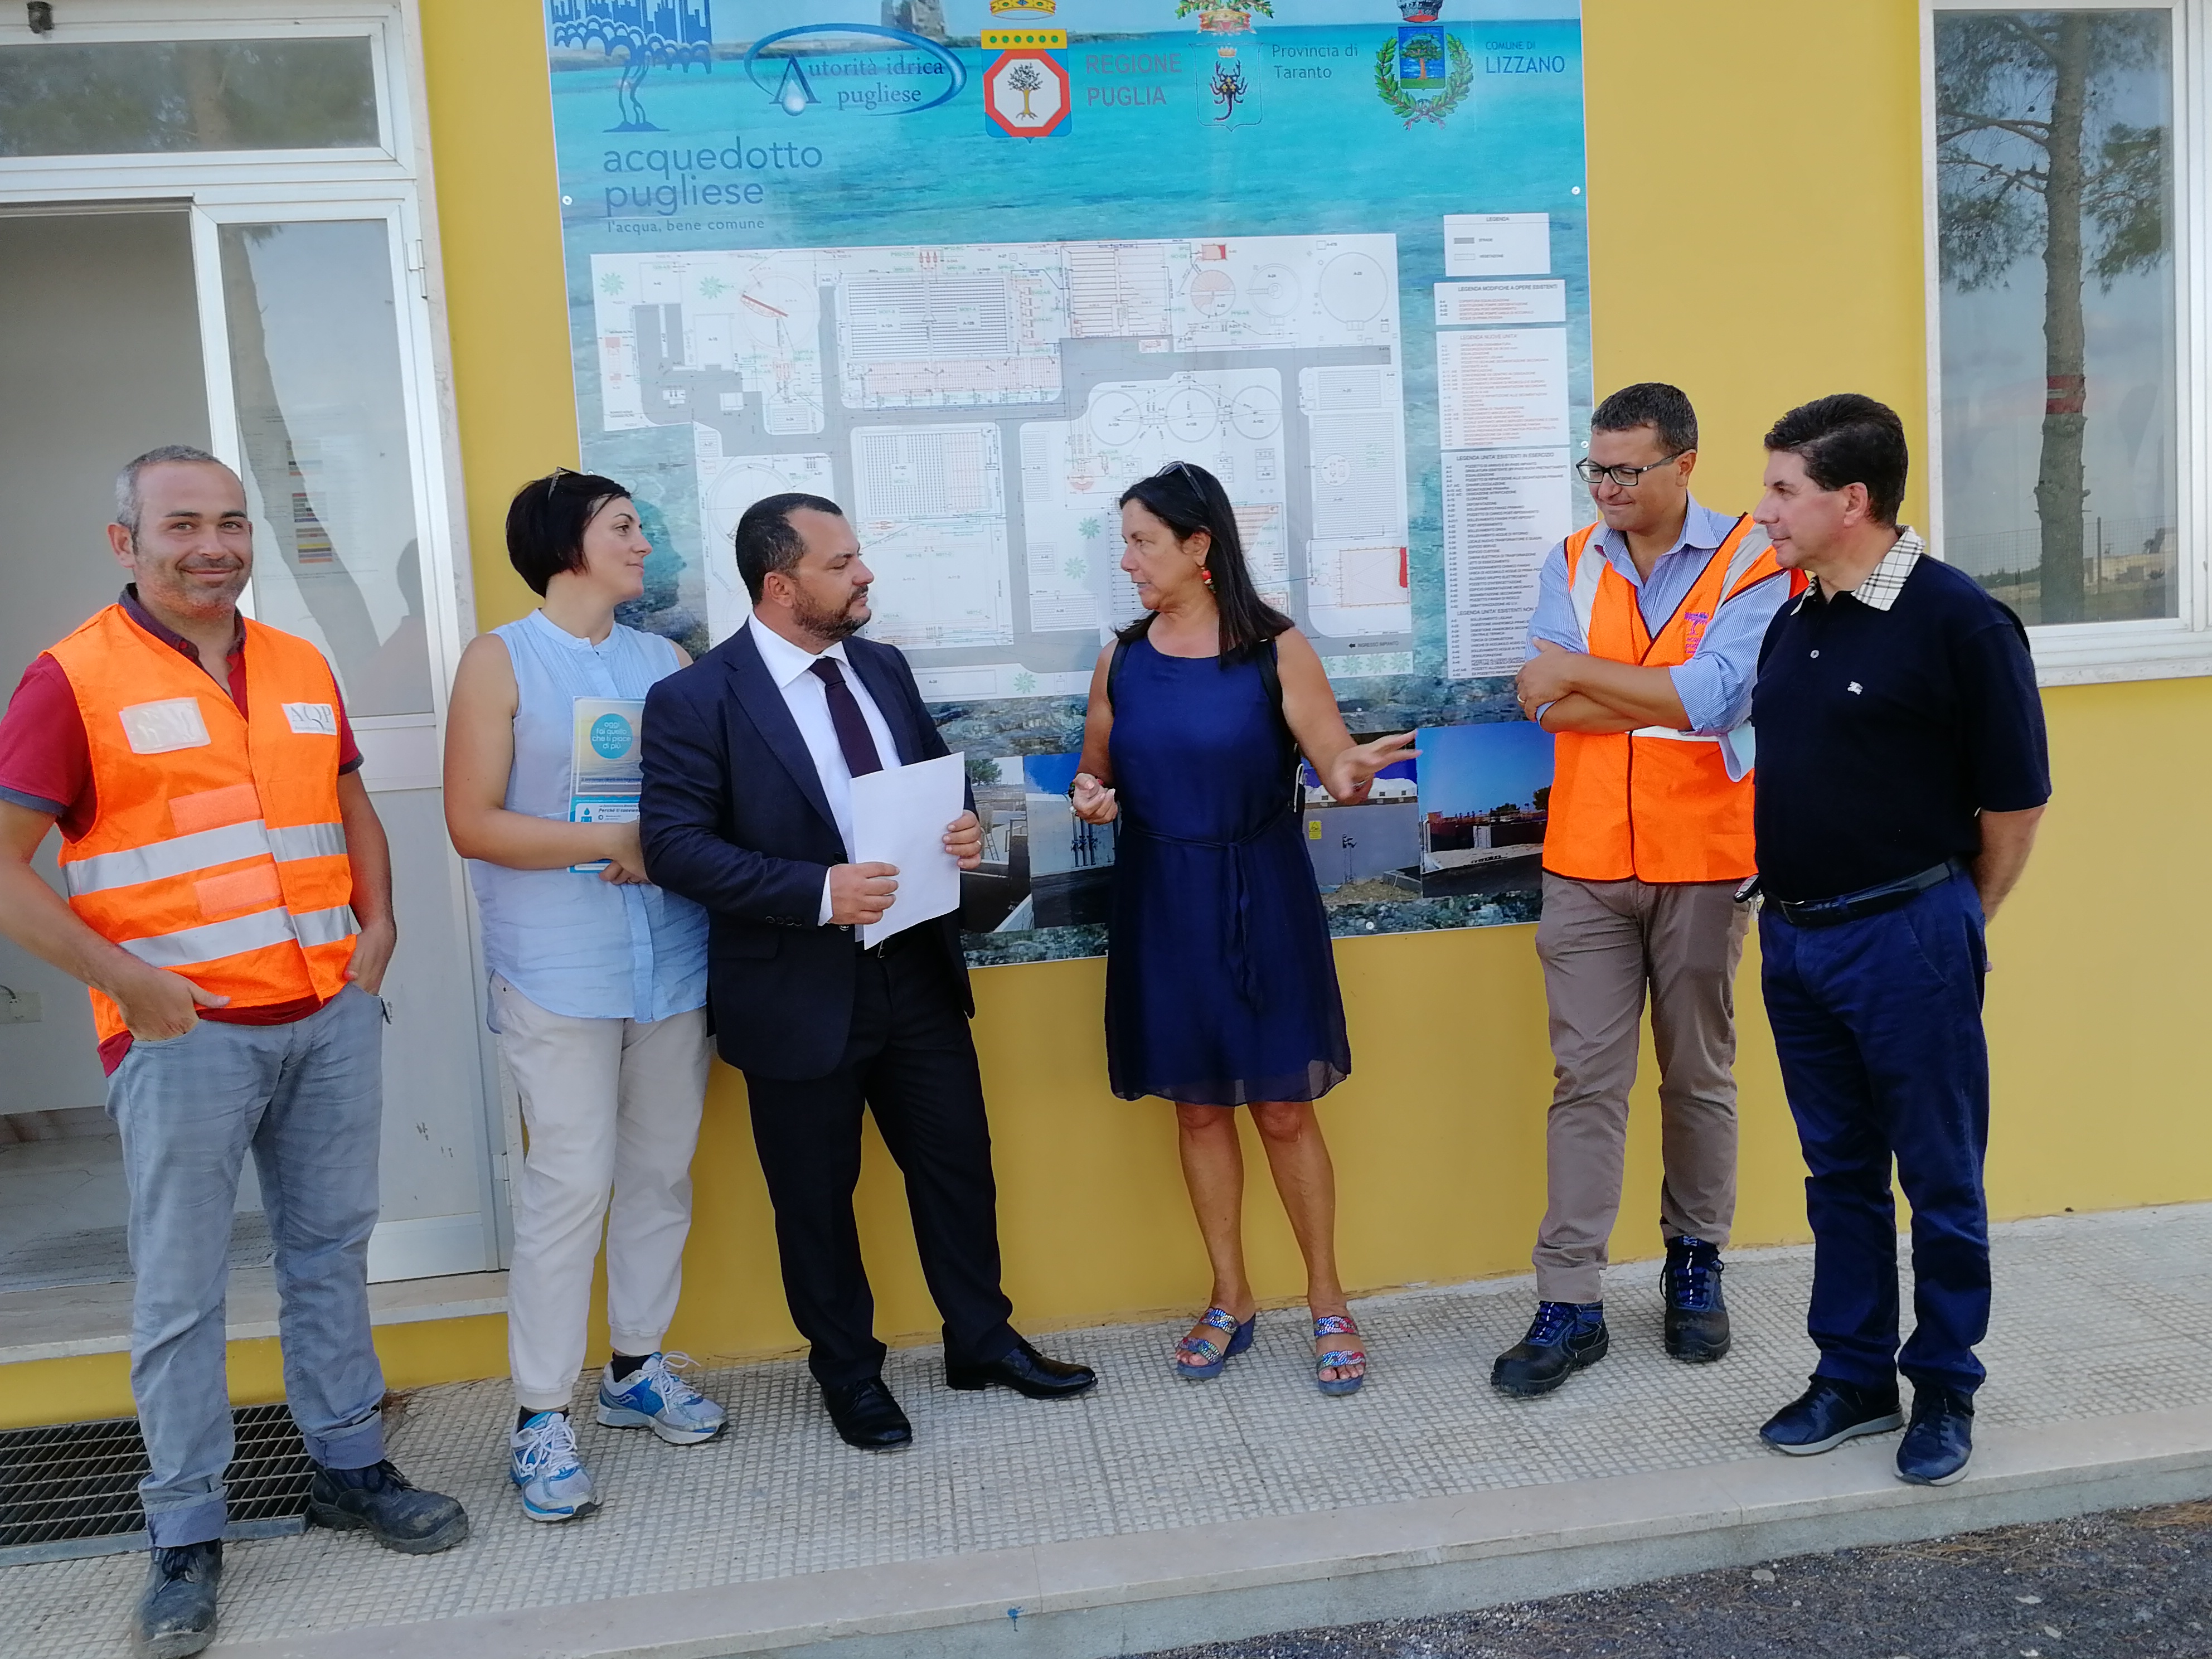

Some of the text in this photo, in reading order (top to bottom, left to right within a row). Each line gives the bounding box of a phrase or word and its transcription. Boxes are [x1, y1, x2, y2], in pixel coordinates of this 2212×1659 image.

[1272, 43, 1358, 58] Provincia di
[1486, 41, 1535, 50] COMUNE DI
[1085, 53, 1182, 75] REGIONE
[1274, 66, 1332, 79] Taranto
[1486, 56, 1565, 74] LIZZANO
[769, 54, 945, 104] Autorità idrica
[837, 82, 921, 111] pugliese
[1087, 86, 1167, 107] PUGLIA
[603, 136, 823, 180] acquedotto
[605, 173, 764, 217] pugliese
[608, 220, 764, 235] l'acqua, bene comune
[290, 706, 331, 730] AQP
